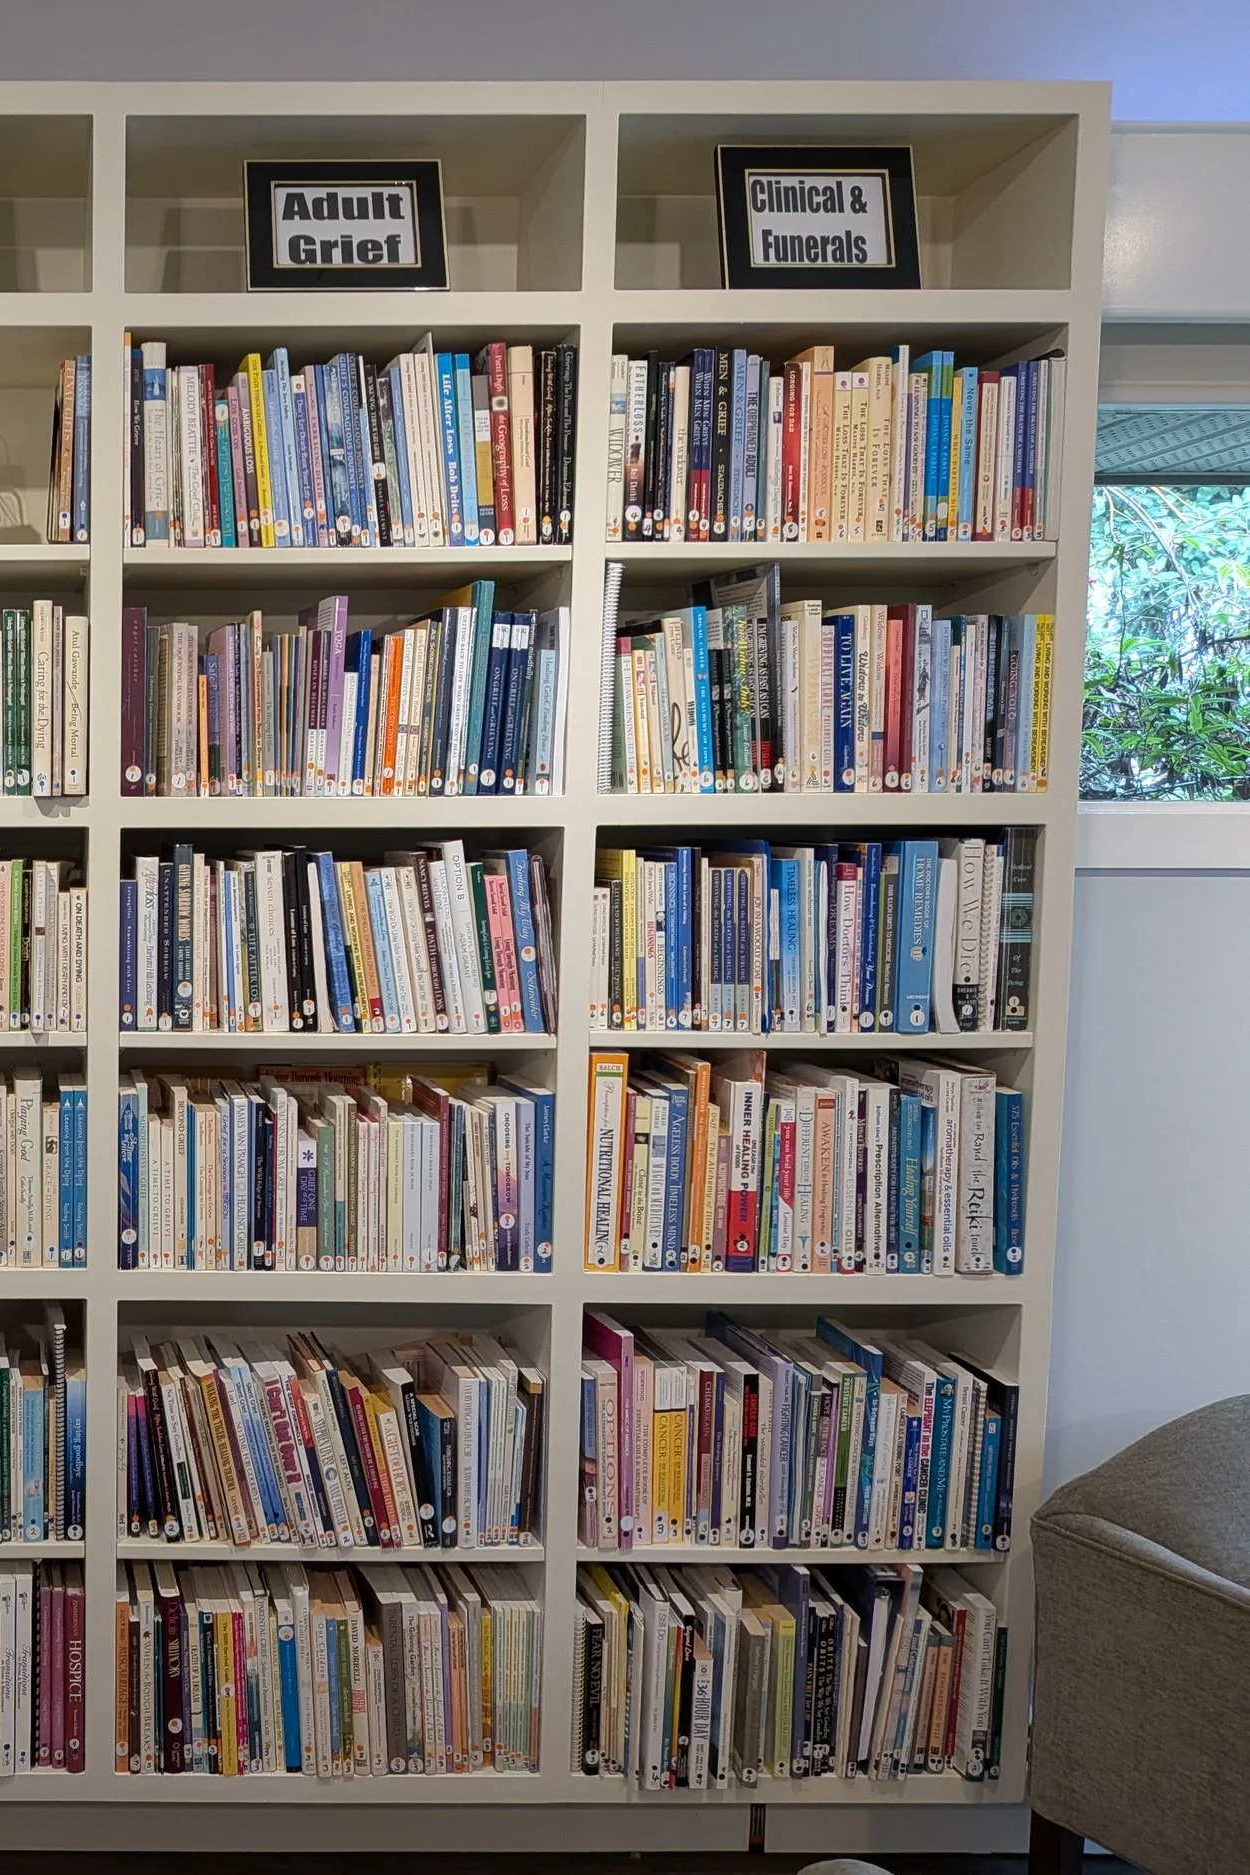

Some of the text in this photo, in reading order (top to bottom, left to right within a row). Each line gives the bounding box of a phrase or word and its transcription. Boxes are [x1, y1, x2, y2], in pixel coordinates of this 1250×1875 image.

[281, 192, 405, 221] Adult
[750, 179, 868, 214] Clinical &
[287, 234, 401, 264] Grief
[761, 230, 868, 264] Funerals
[717, 353, 727, 436] MEN & GRIEF
[443, 374, 455, 454] Life After Loss
[499, 415, 507, 424] the
[242, 408, 254, 474] AMBIGUOUS LOSS
[496, 425, 509, 479] Geography
[746, 392, 758, 479] THE ORPHANED ADULT
[501, 488, 510, 511] Loss
[71, 630, 79, 649] Atul
[334, 629, 342, 654] YOGA
[71, 651, 79, 689] Gawande
[841, 633, 852, 728] TO LIVE AGAIN
[36, 651, 47, 749] Caring for the Dying
[70, 703, 78, 727] Being
[452, 855, 464, 891] OPTION
[76, 902, 82, 914] ON
[960, 846, 981, 973] How We Die
[739, 1092, 753, 1222] INNER HEALING POWER
[784, 1154, 792, 1169] heal
[596, 1128, 614, 1245] NUTRITIONAL HEALIN
[667, 1113, 686, 1248] AGELESS BODY TIMELESS MIND
[783, 1188, 791, 1199] life
[925, 1382, 934, 1396] The
[923, 1398, 933, 1433] ELEPHANT
[74, 1418, 83, 1477] saying goodbye
[606, 1399, 615, 1516] OPTIONS
[921, 1443, 930, 1457] the
[344, 1472, 353, 1492] ALIVE
[919, 1458, 929, 1487] CANCER
[918, 1489, 928, 1514] CLINIC
[984, 1614, 994, 1630] You
[983, 1632, 993, 1654] Can't
[69, 1640, 82, 1702] HOSPICE
[118, 1646, 127, 1705] MISCARRIAGE
[589, 1629, 601, 1707] FEAR NO EVIL
[981, 1656, 991, 1677] Take
[694, 1684, 709, 1740] 36-HOUR DAY
[979, 1687, 989, 1709] With
[977, 1710, 987, 1727] You
